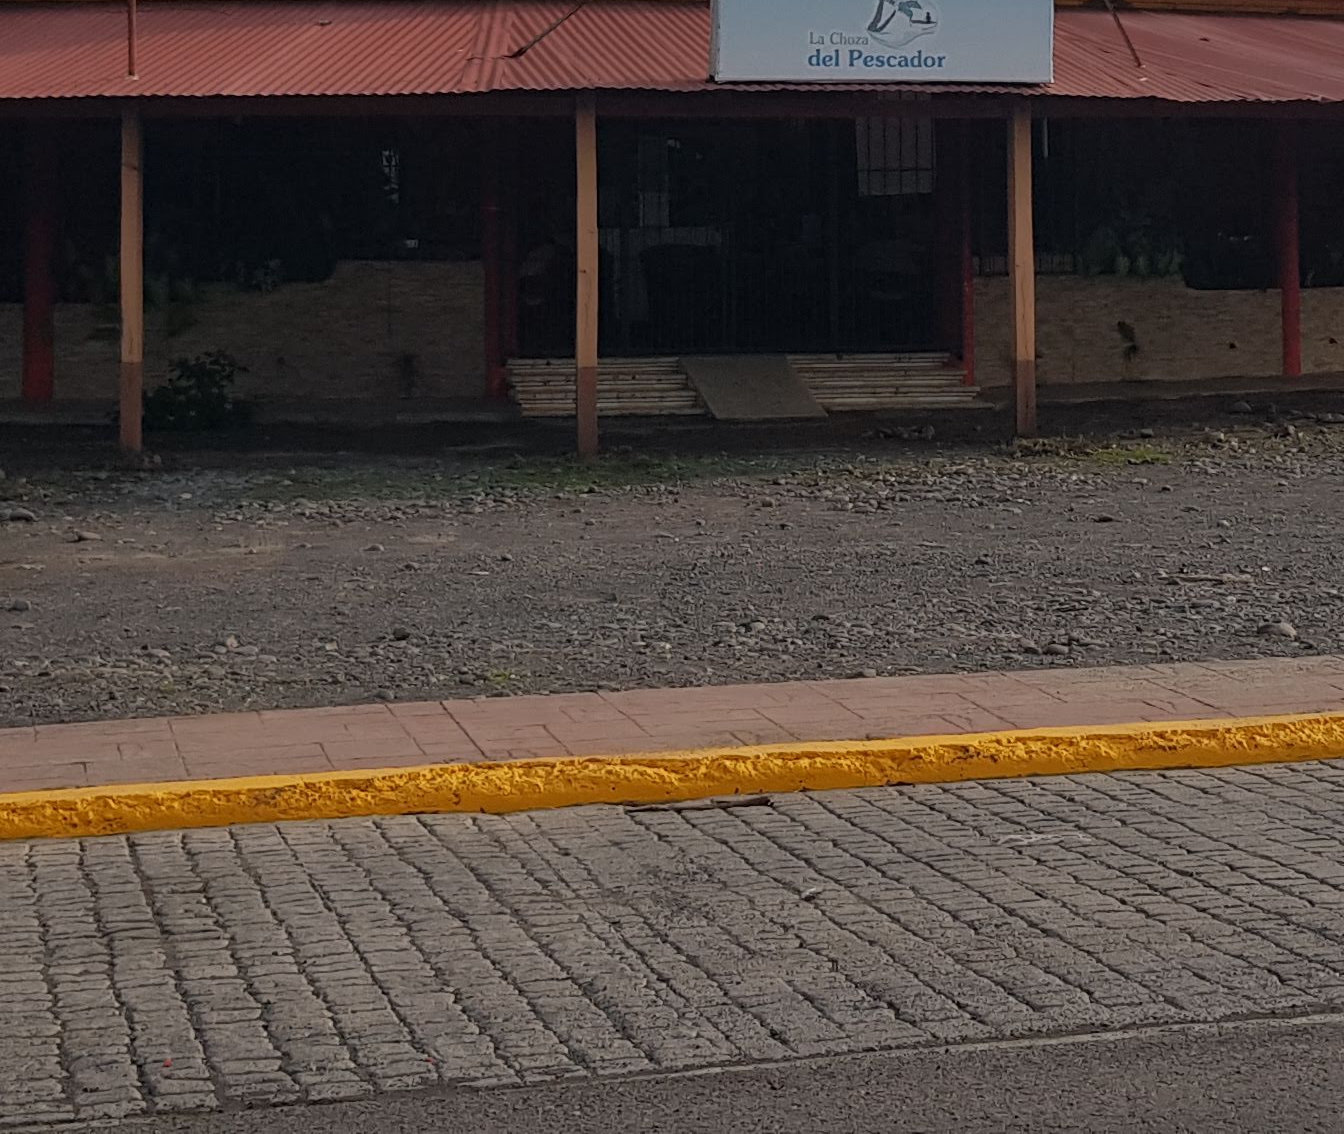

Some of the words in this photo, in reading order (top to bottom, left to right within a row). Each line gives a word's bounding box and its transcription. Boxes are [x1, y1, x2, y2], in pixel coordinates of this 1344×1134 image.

[809, 32, 825, 45] La
[829, 32, 869, 46] Choza
[807, 49, 840, 67] del
[848, 49, 946, 68] Pescador
